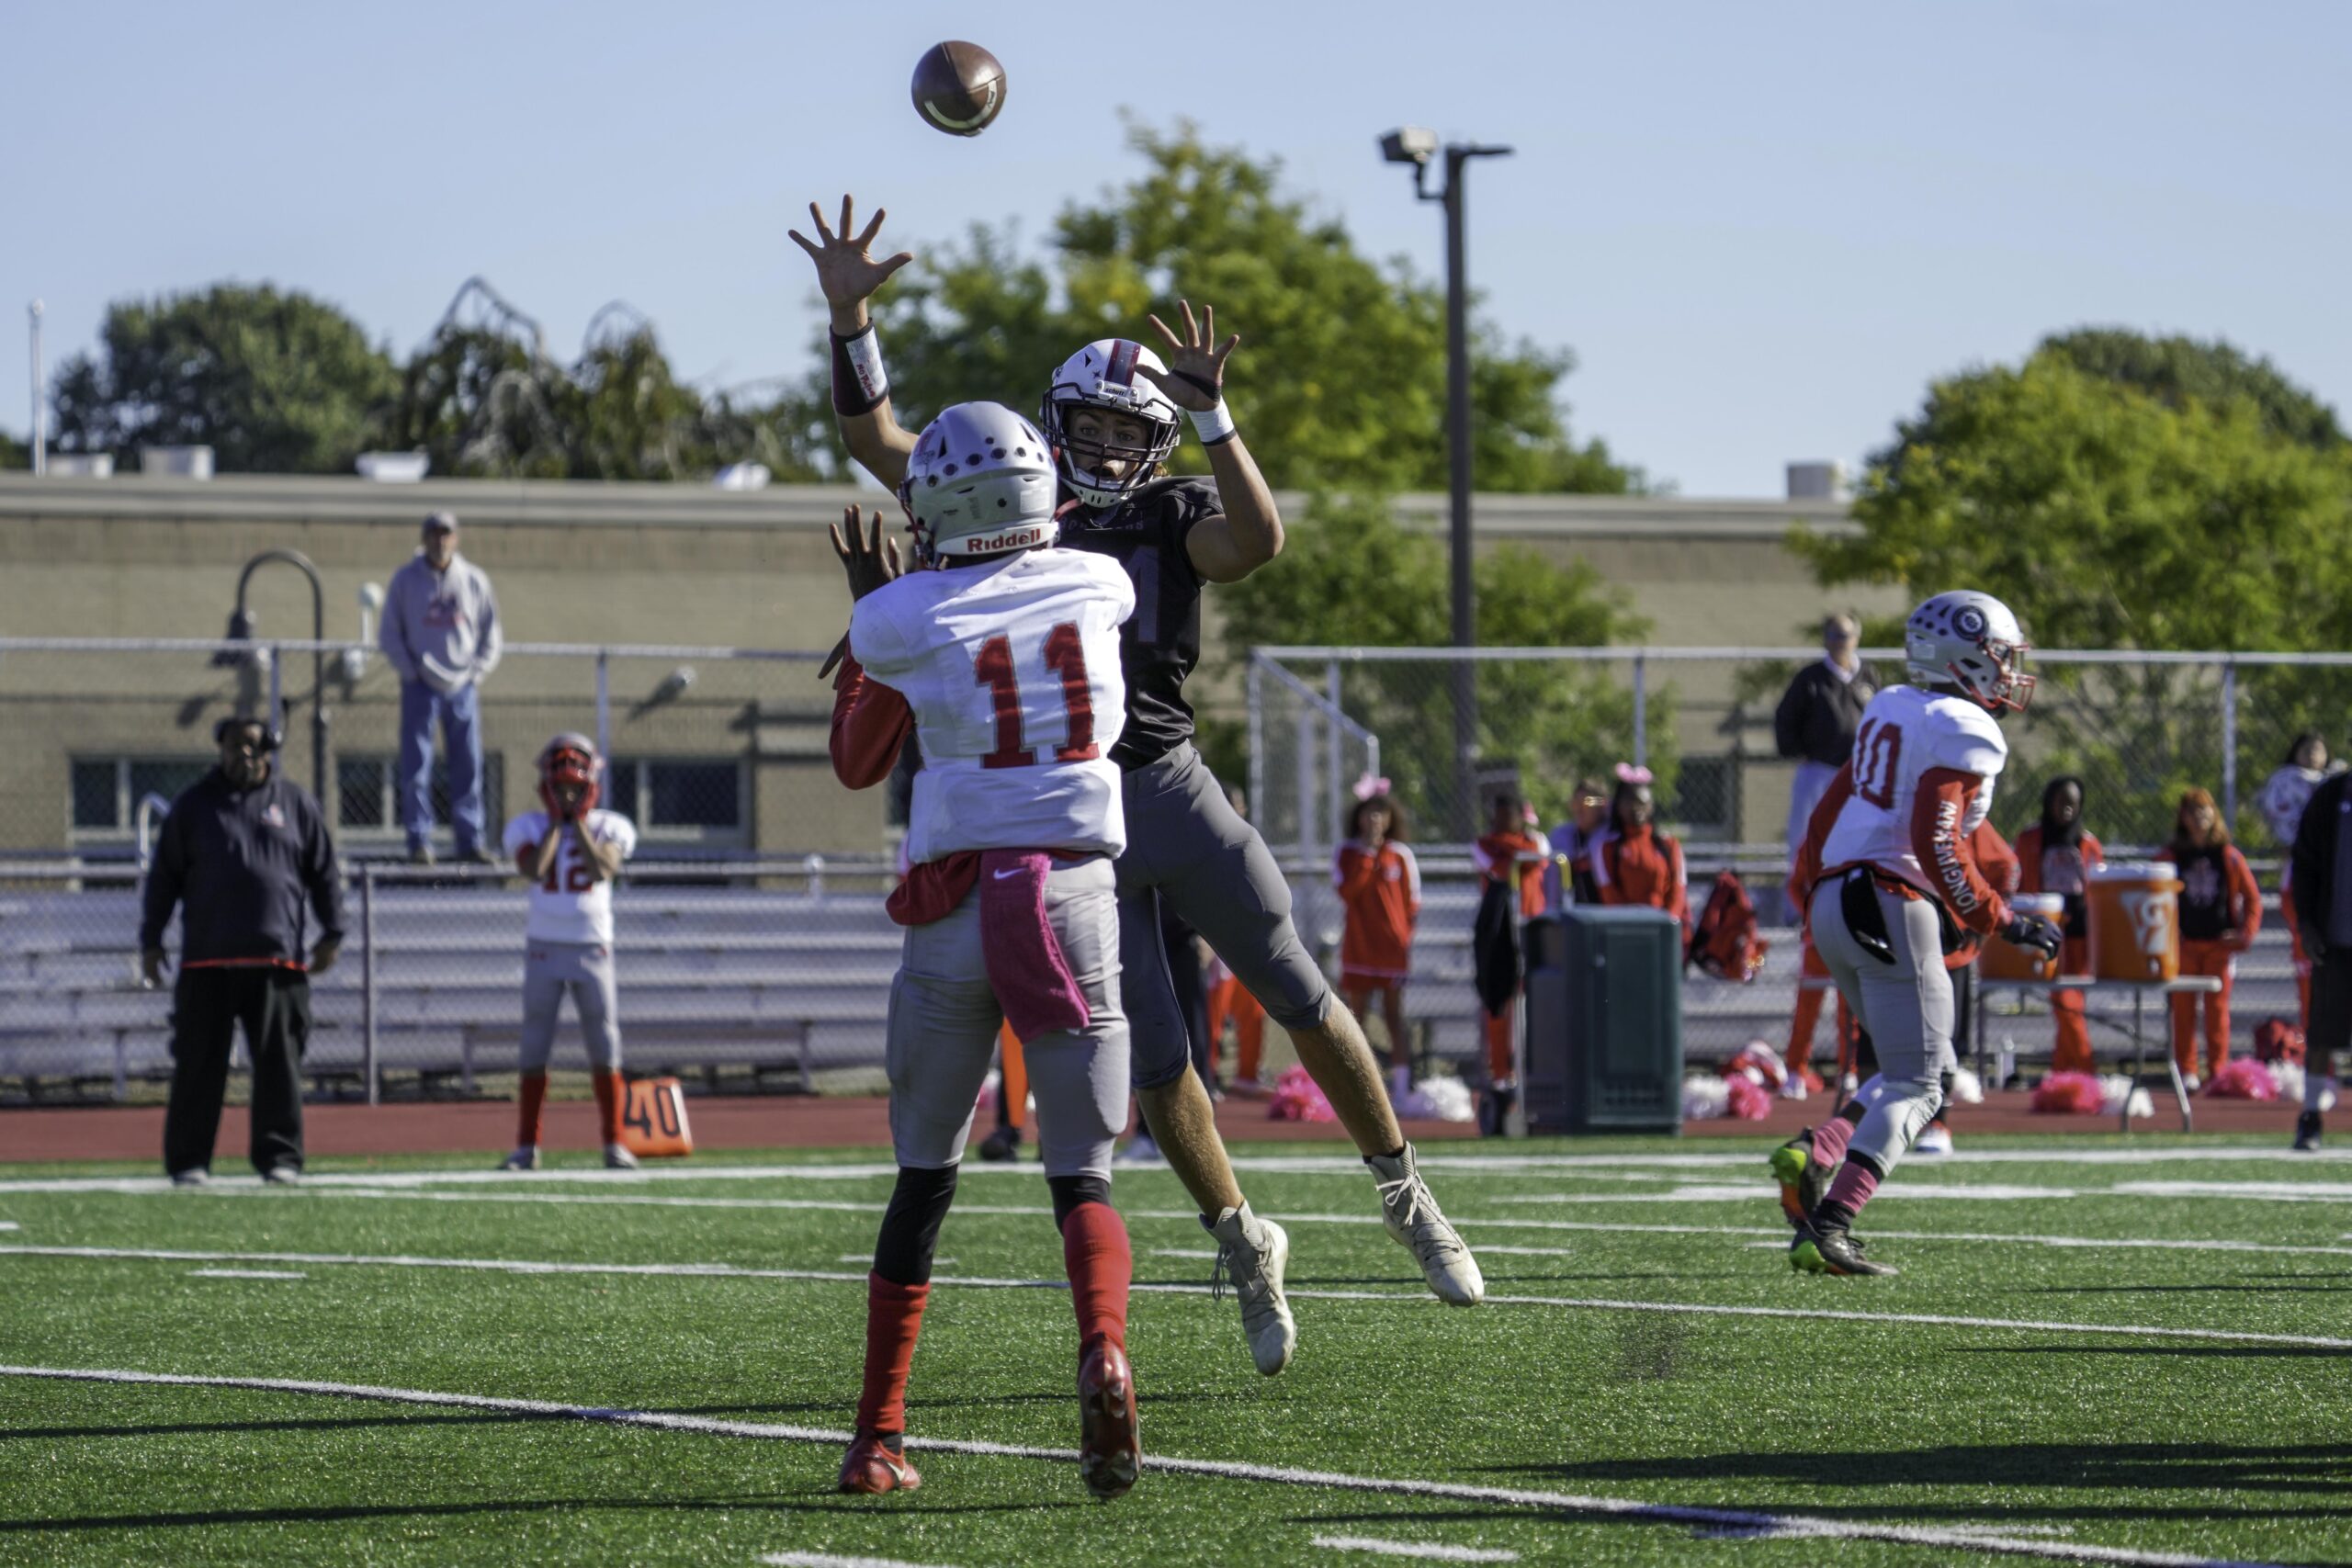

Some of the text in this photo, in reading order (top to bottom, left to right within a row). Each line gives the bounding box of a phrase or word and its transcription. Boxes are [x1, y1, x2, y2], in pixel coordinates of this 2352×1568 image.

[967, 528, 1041, 552] Riddell
[974, 619, 1101, 770] 11
[1855, 716, 1902, 809] 10
[623, 1086, 681, 1140] 40
